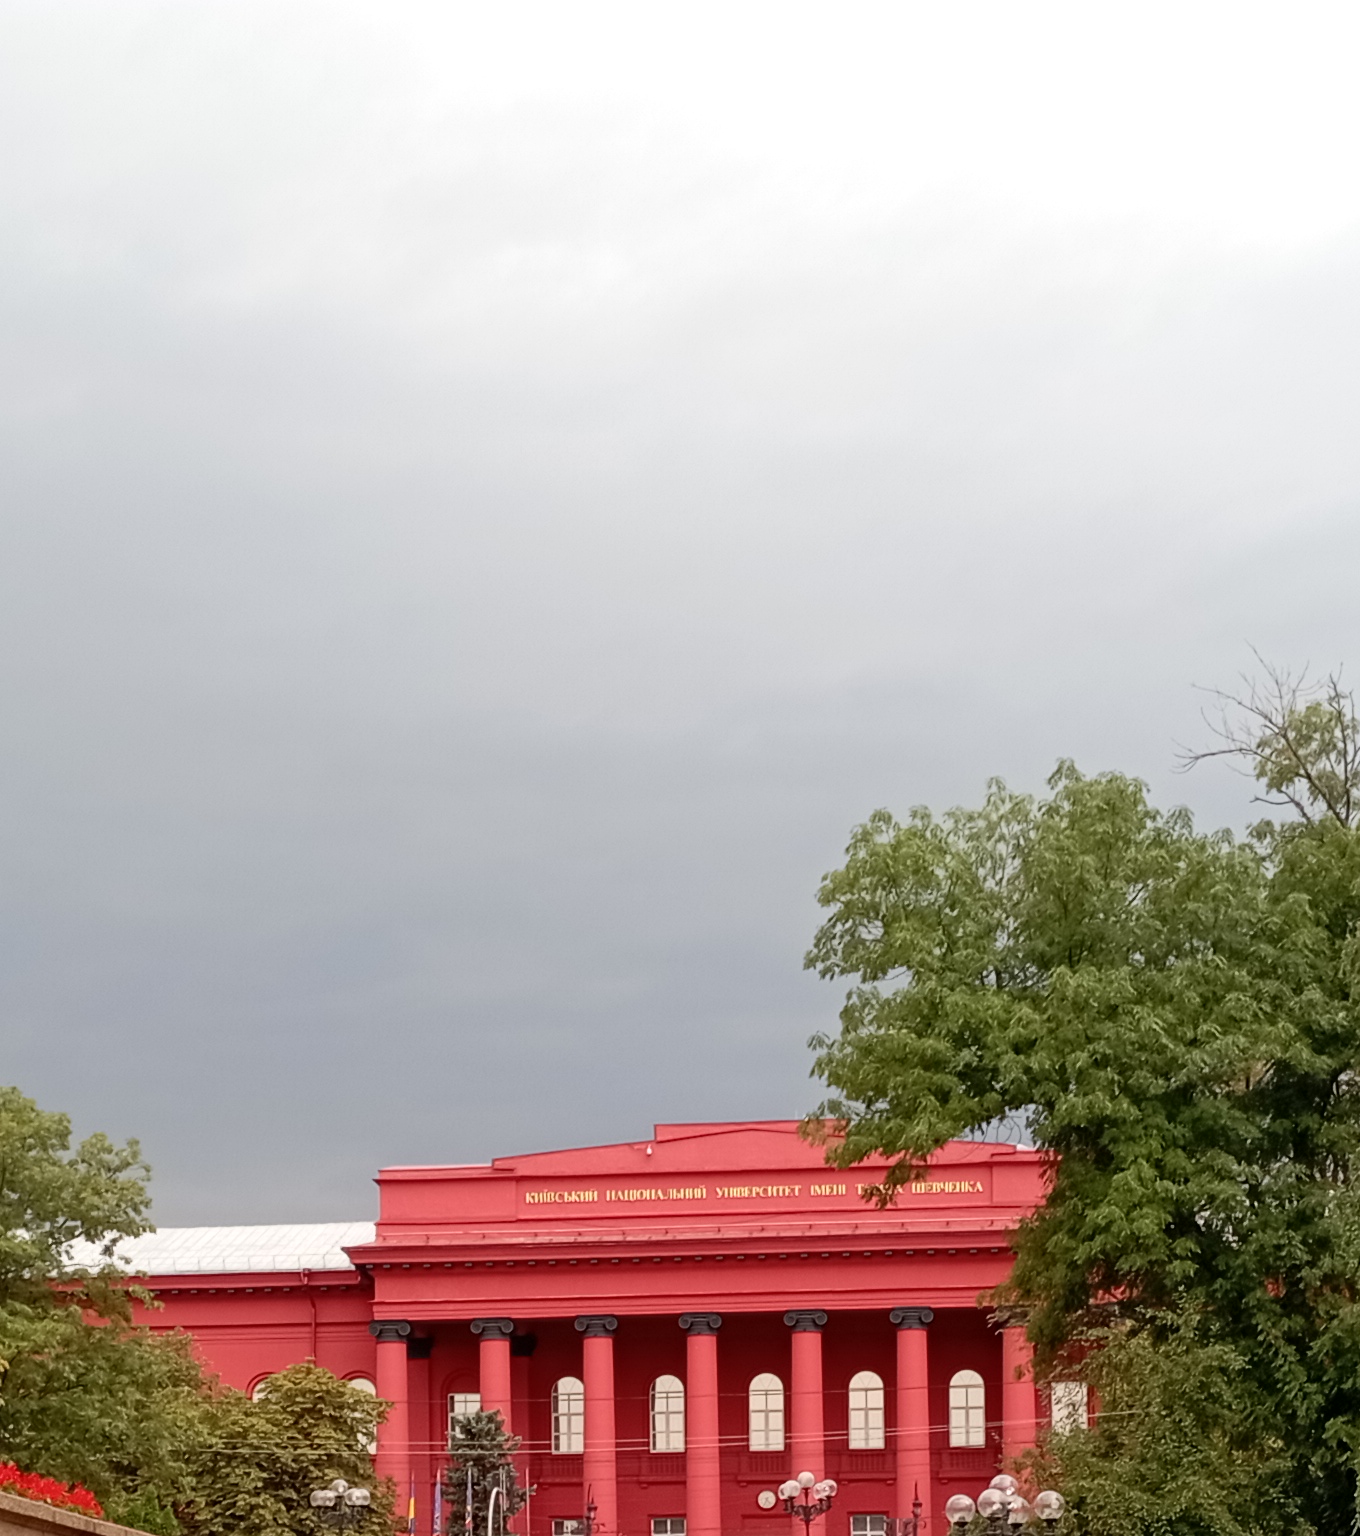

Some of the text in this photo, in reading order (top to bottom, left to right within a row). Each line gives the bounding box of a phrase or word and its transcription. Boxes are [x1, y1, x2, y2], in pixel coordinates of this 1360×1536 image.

[525, 1188, 598, 1204] КИЇВСЬКИЙ
[606, 1185, 707, 1202] НАЦІОНАЛЬНИЙ
[715, 1184, 801, 1199] УНІВЕРСИТЕТ
[810, 1184, 846, 1196] ІМЕНІ
[911, 1181, 983, 1195] ШЕВЧЕНКА
